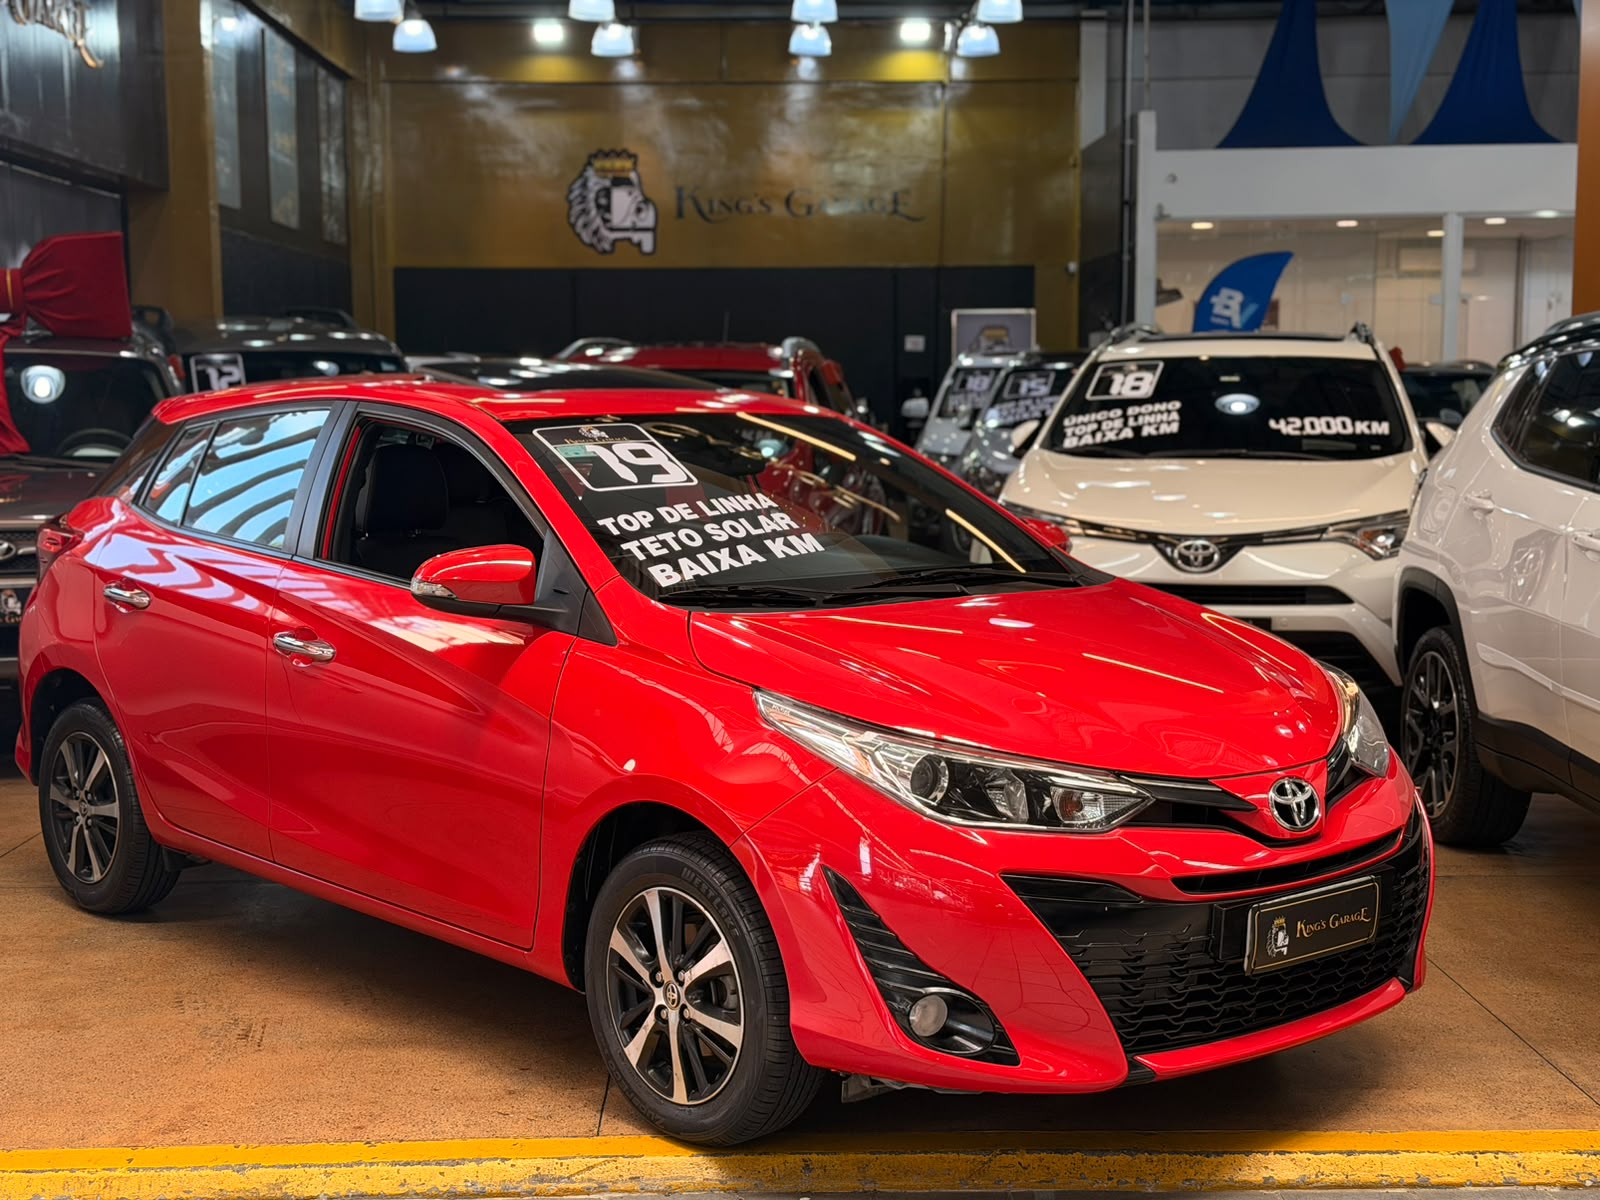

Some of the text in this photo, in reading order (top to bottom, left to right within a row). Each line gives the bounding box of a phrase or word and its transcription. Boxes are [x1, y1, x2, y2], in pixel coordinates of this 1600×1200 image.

[1107, 371, 1154, 397] 18
[1063, 408, 1123, 427] ÚNICO
[1126, 400, 1181, 416] DONO
[1064, 411, 1180, 438] TOP DE LINHA
[1063, 422, 1180, 448] BAIXA KM
[575, 442, 688, 484] 19
[597, 492, 779, 536] TOP DE LINHA
[620, 512, 799, 561] TETO SOLAR
[647, 532, 825, 587] BAIXA KM
[1296, 907, 1371, 938] KING'S GARAGE
